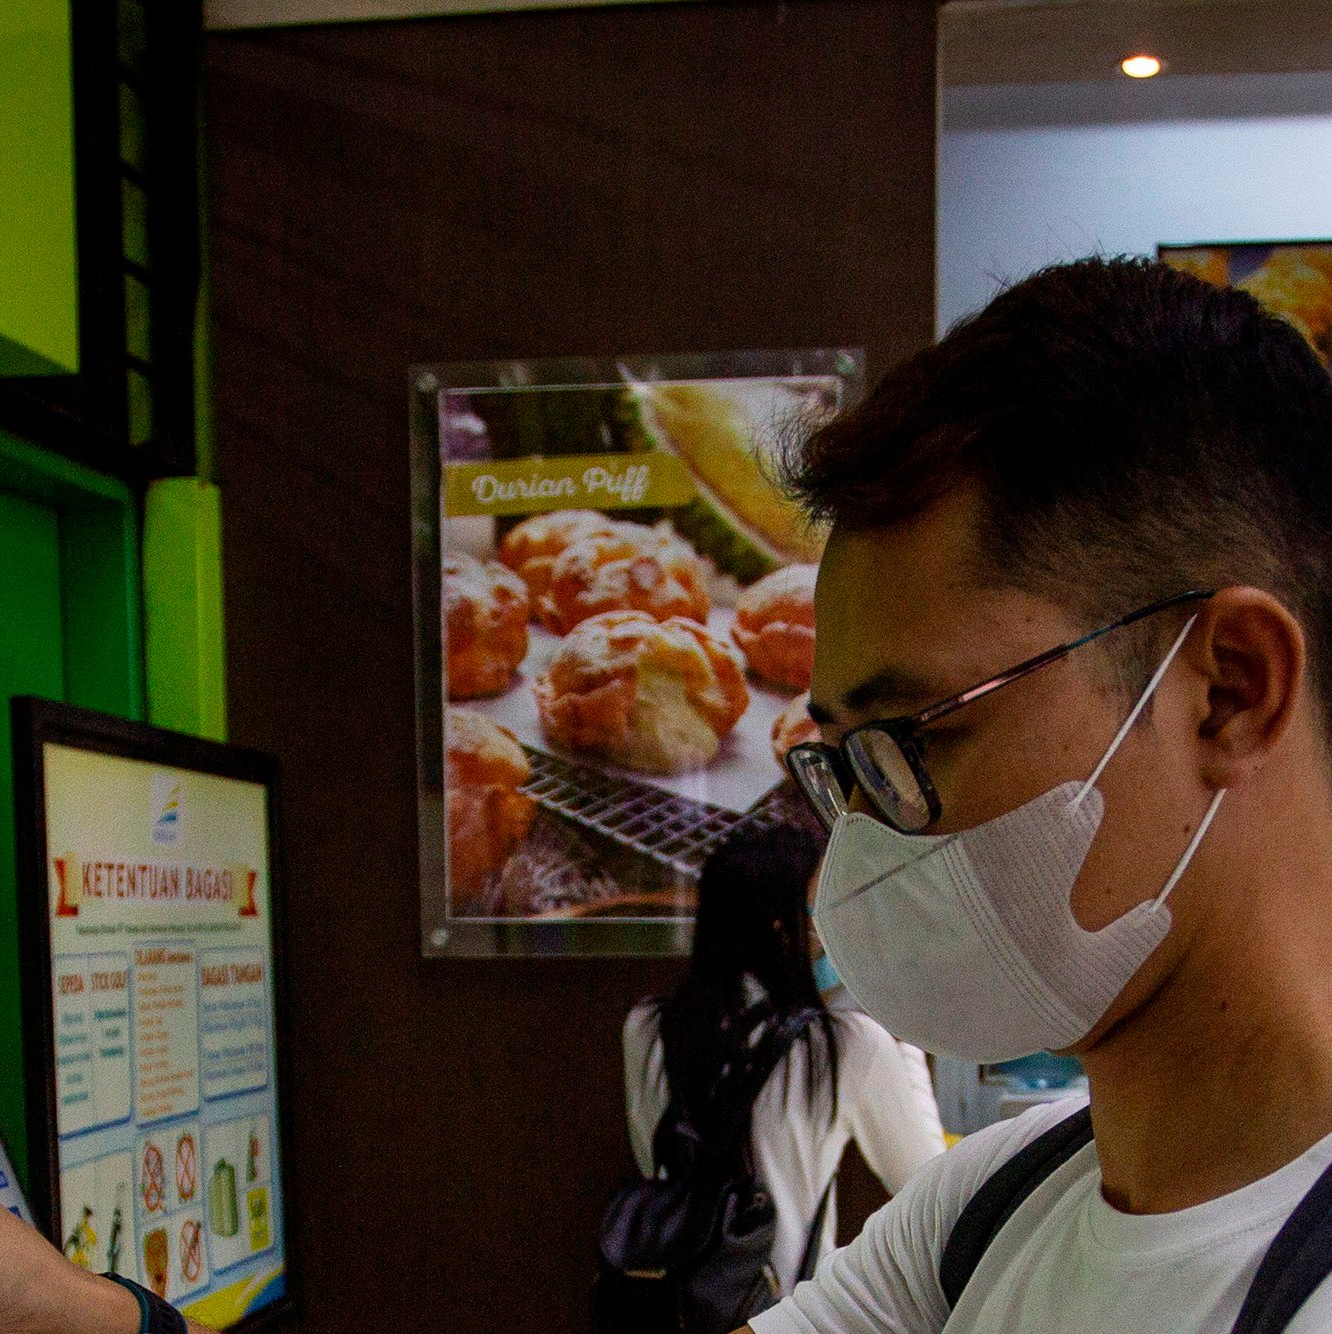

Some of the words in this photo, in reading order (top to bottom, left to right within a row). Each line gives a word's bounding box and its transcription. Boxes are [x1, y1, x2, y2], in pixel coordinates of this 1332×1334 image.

[472, 473, 578, 503] Durian
[582, 465, 651, 503] Puff
[82, 861, 180, 898] KETENTUAN
[185, 866, 235, 901] BAGASI
